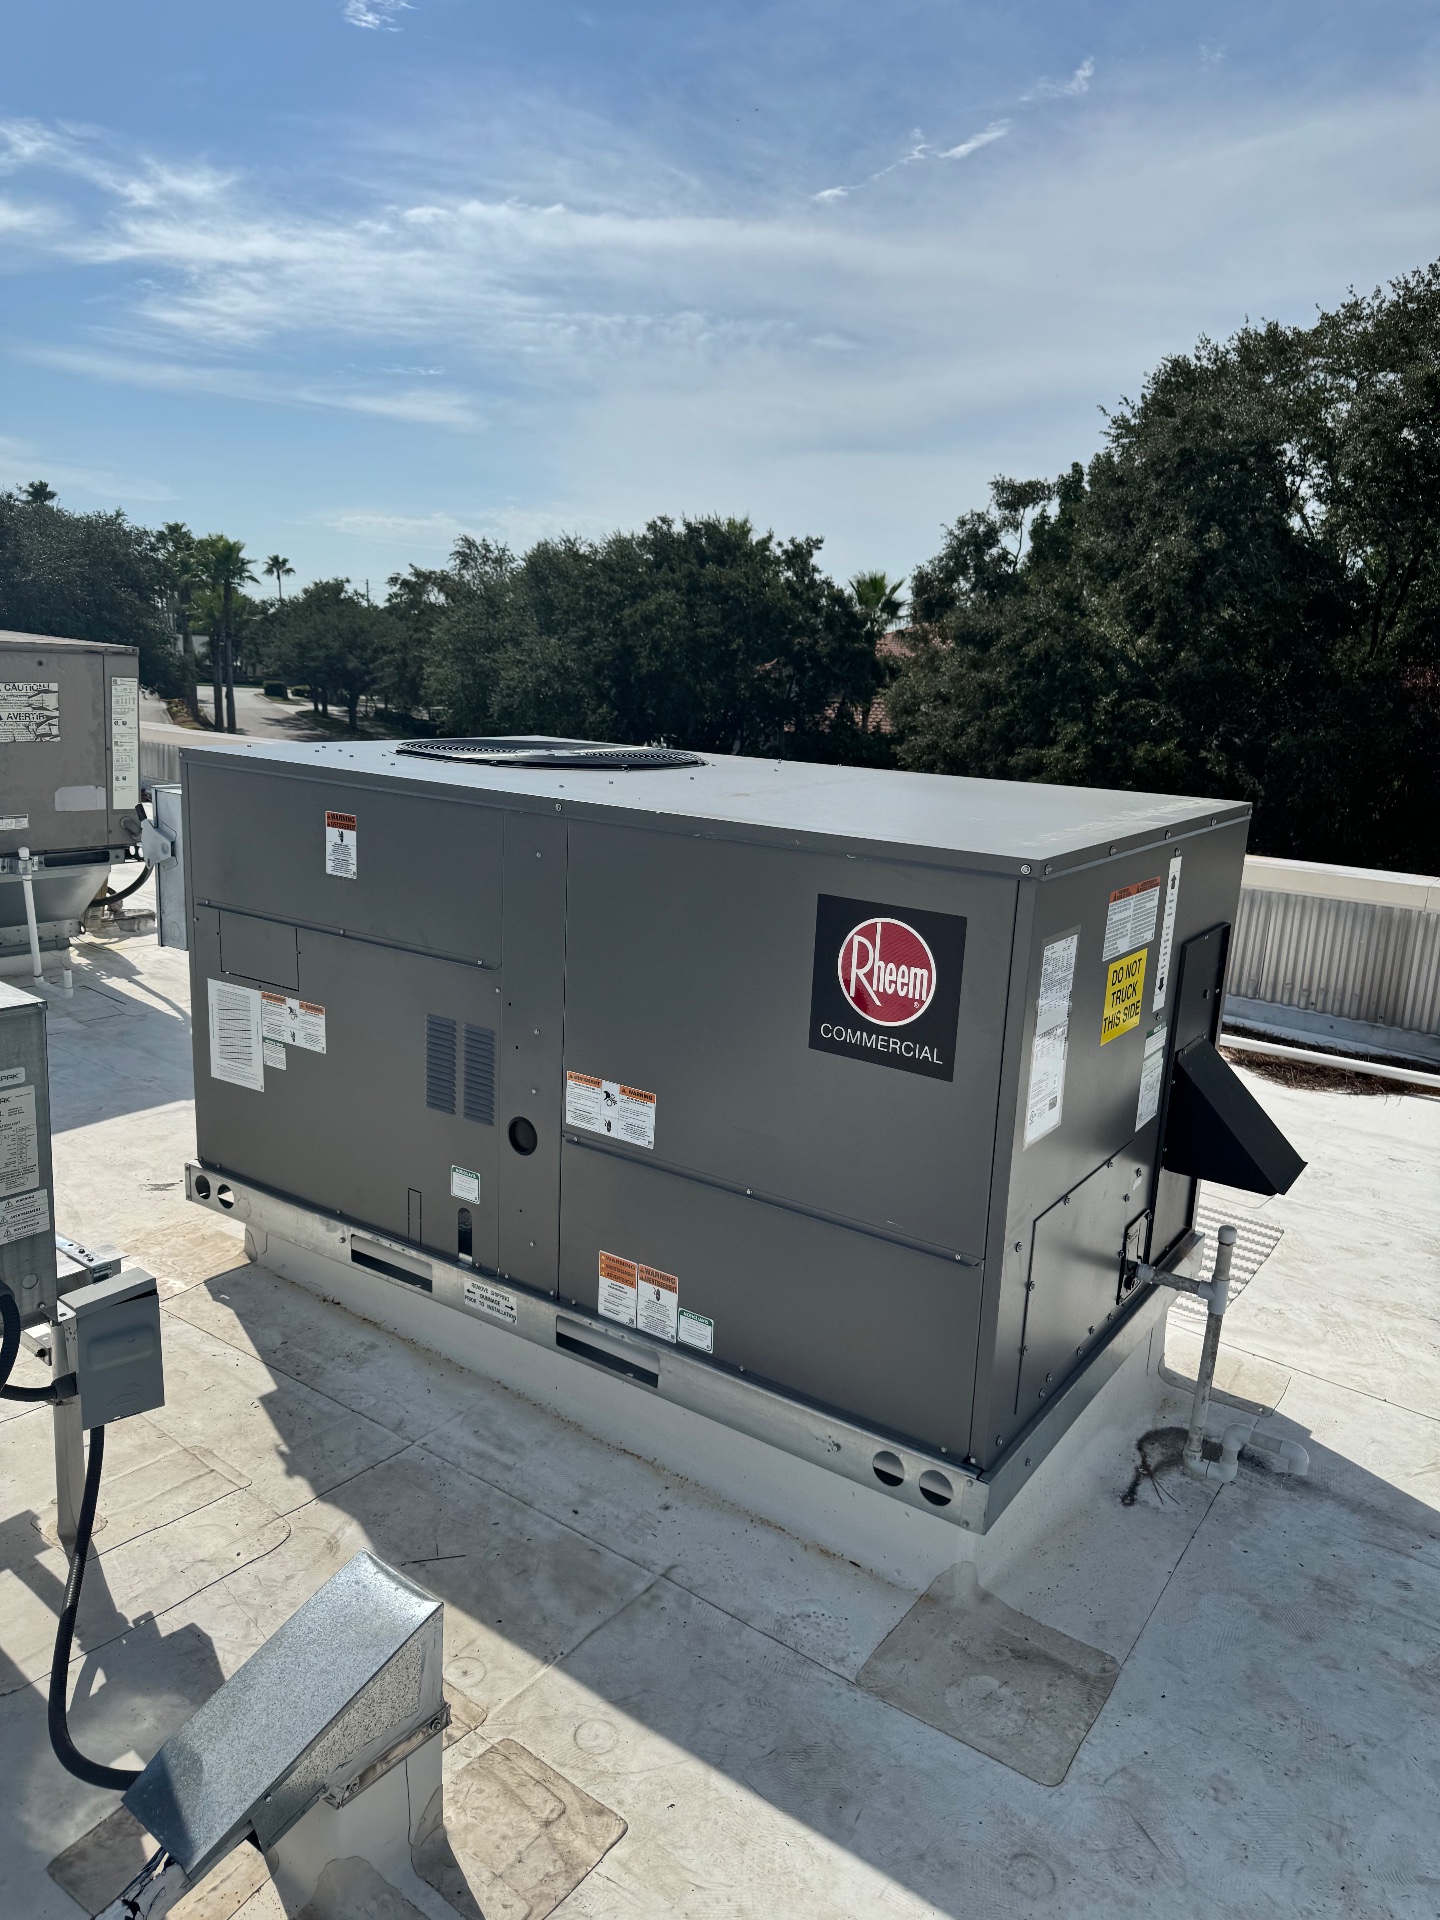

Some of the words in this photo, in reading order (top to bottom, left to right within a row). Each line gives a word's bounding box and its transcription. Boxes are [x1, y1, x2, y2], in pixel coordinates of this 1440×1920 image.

[850, 922, 928, 1006] Rheem
[1111, 966, 1124, 987] DO
[1125, 958, 1142, 980] NOT
[1111, 980, 1138, 1008] TRUCK
[1103, 1009, 1121, 1034] THIS
[1122, 1000, 1140, 1023] SIDE
[820, 1023, 943, 1065] COMMERCIAL
[628, 1089, 653, 1101] WARNING
[605, 1255, 636, 1270] WARNING
[644, 1267, 676, 1284] WARNING
[471, 1282, 489, 1294] REMOVE
[490, 1290, 510, 1302] SHIPPING
[464, 1295, 477, 1304] PRIOR
[486, 1304, 517, 1321] INSTALLATION
